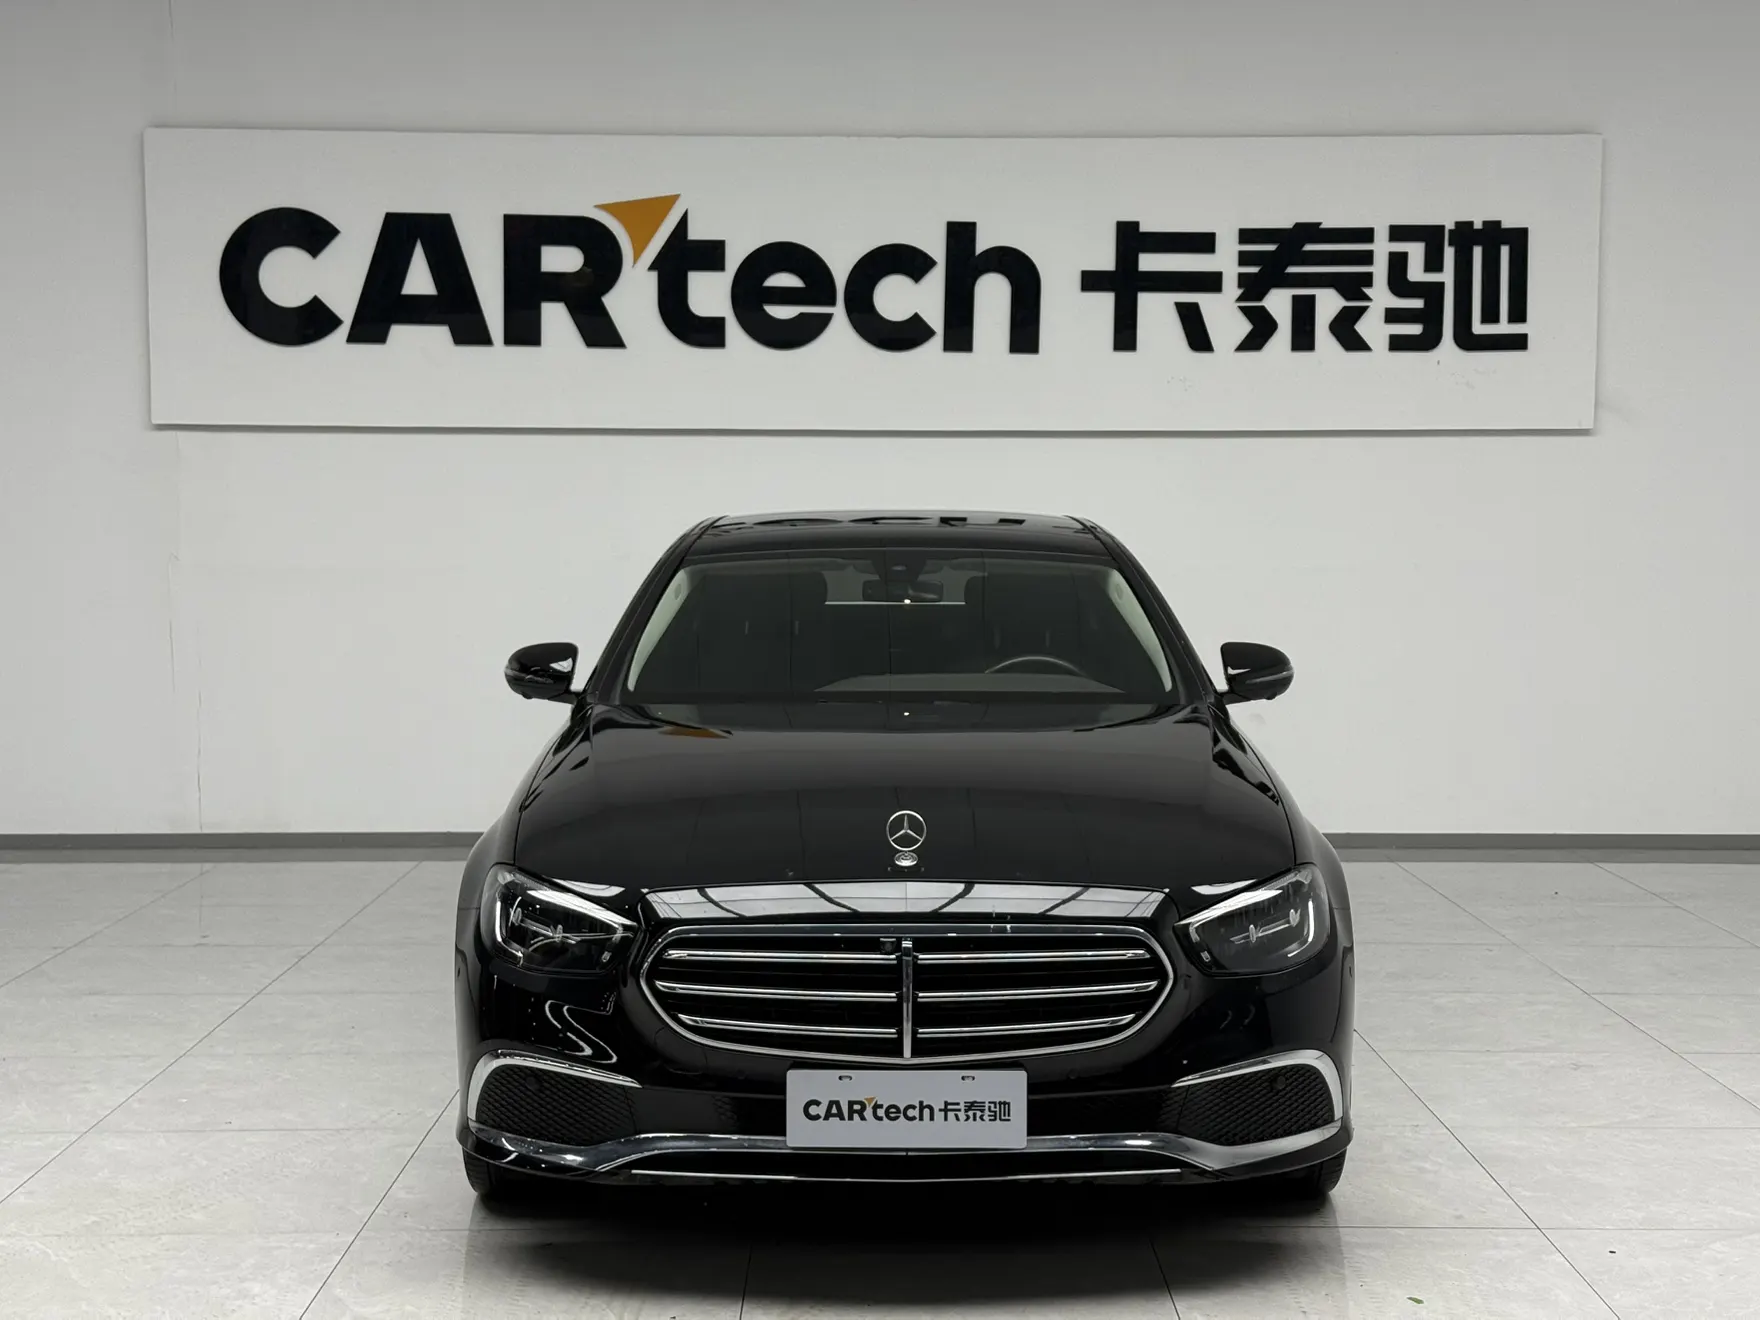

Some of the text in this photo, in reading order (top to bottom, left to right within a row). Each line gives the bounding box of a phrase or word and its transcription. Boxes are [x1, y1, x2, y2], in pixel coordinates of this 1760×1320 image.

[219, 207, 1528, 354] CARtech 卡泰驰
[803, 1098, 1012, 1122] CARtech 卡泰驰
